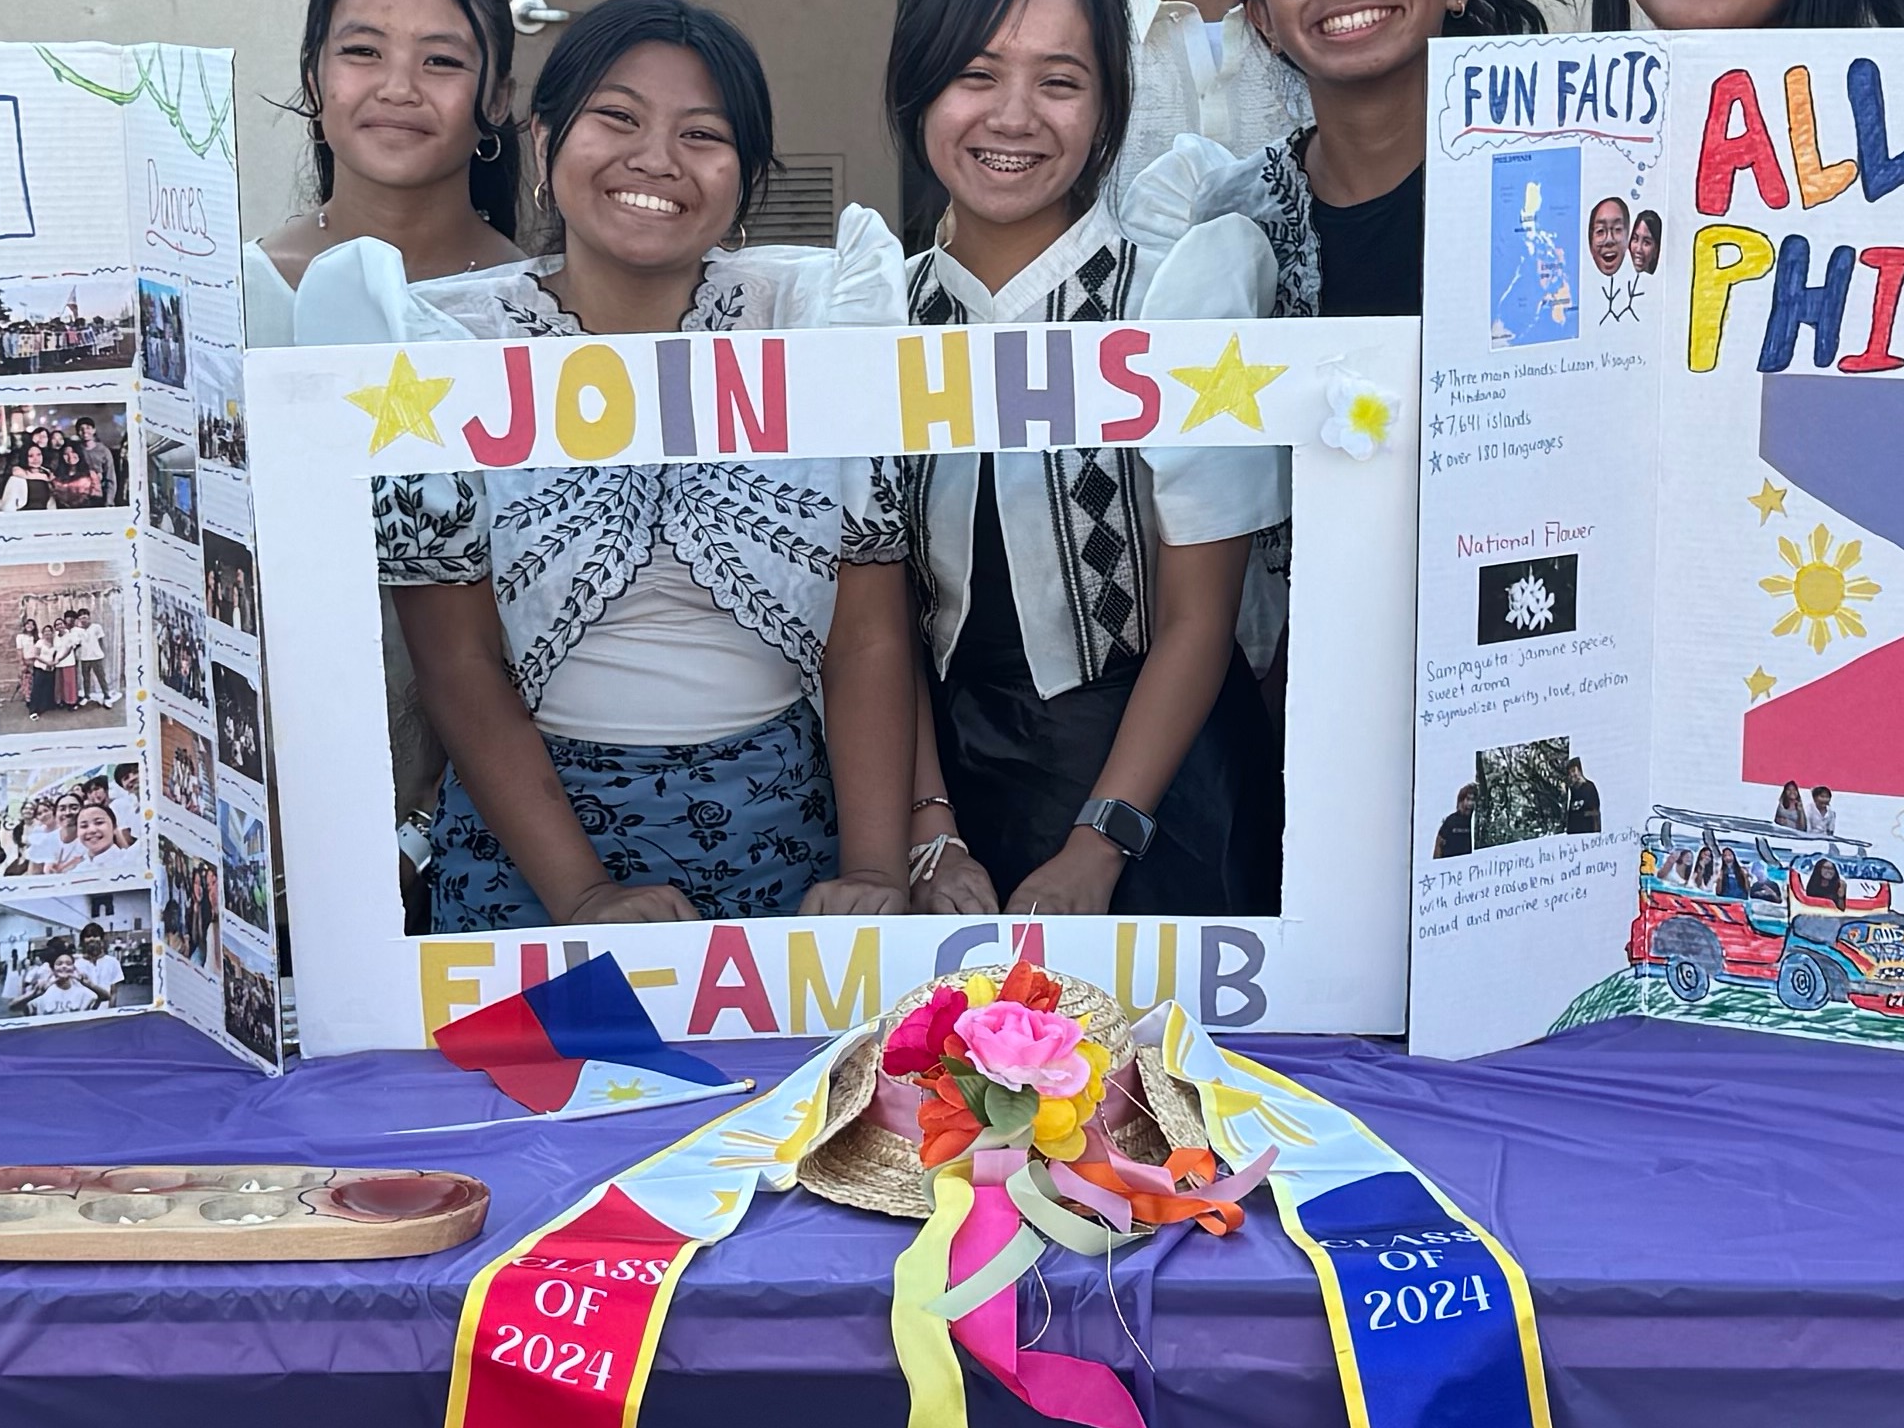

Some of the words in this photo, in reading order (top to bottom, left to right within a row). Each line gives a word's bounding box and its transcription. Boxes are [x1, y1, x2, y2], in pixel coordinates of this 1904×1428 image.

[1464, 60, 1538, 127] FUN
[1557, 50, 1661, 127] FACTS
[147, 158, 207, 236] Dances
[1448, 369, 1477, 387] Three
[1481, 370, 1510, 383] main
[461, 337, 789, 467] JOIN
[897, 328, 1162, 452] HHS
[1450, 389, 1506, 406] Mindanao
[1446, 413, 1480, 438] 7,641
[1487, 409, 1532, 430] islands
[1446, 452, 1472, 468] over
[1478, 444, 1499, 462] 180
[1503, 435, 1564, 459] languages
[1457, 529, 1535, 558] National
[1545, 521, 1596, 547] Flower
[1518, 644, 1566, 667] jasmine
[1427, 687, 1465, 703] sweet
[1471, 676, 1511, 692] aroma
[1579, 672, 1629, 693] devotion
[1419, 895, 1448, 916] with
[1454, 885, 1489, 907] diverse
[1560, 863, 1581, 880] and
[1585, 860, 1618, 877] many
[1439, 872, 1463, 890] The
[1468, 855, 1535, 883] Philippines
[1466, 909, 1490, 927] and
[1496, 899, 1539, 920] marine
[1544, 886, 1588, 912] species
[419, 924, 881, 1049] F-AM
[1318, 1229, 1481, 1250] CLASS
[512, 1256, 671, 1285] CLASS
[1378, 1249, 1444, 1271] OF
[534, 1280, 607, 1326] OF
[1364, 1274, 1492, 1331] 2024
[491, 1324, 614, 1392] 2024
